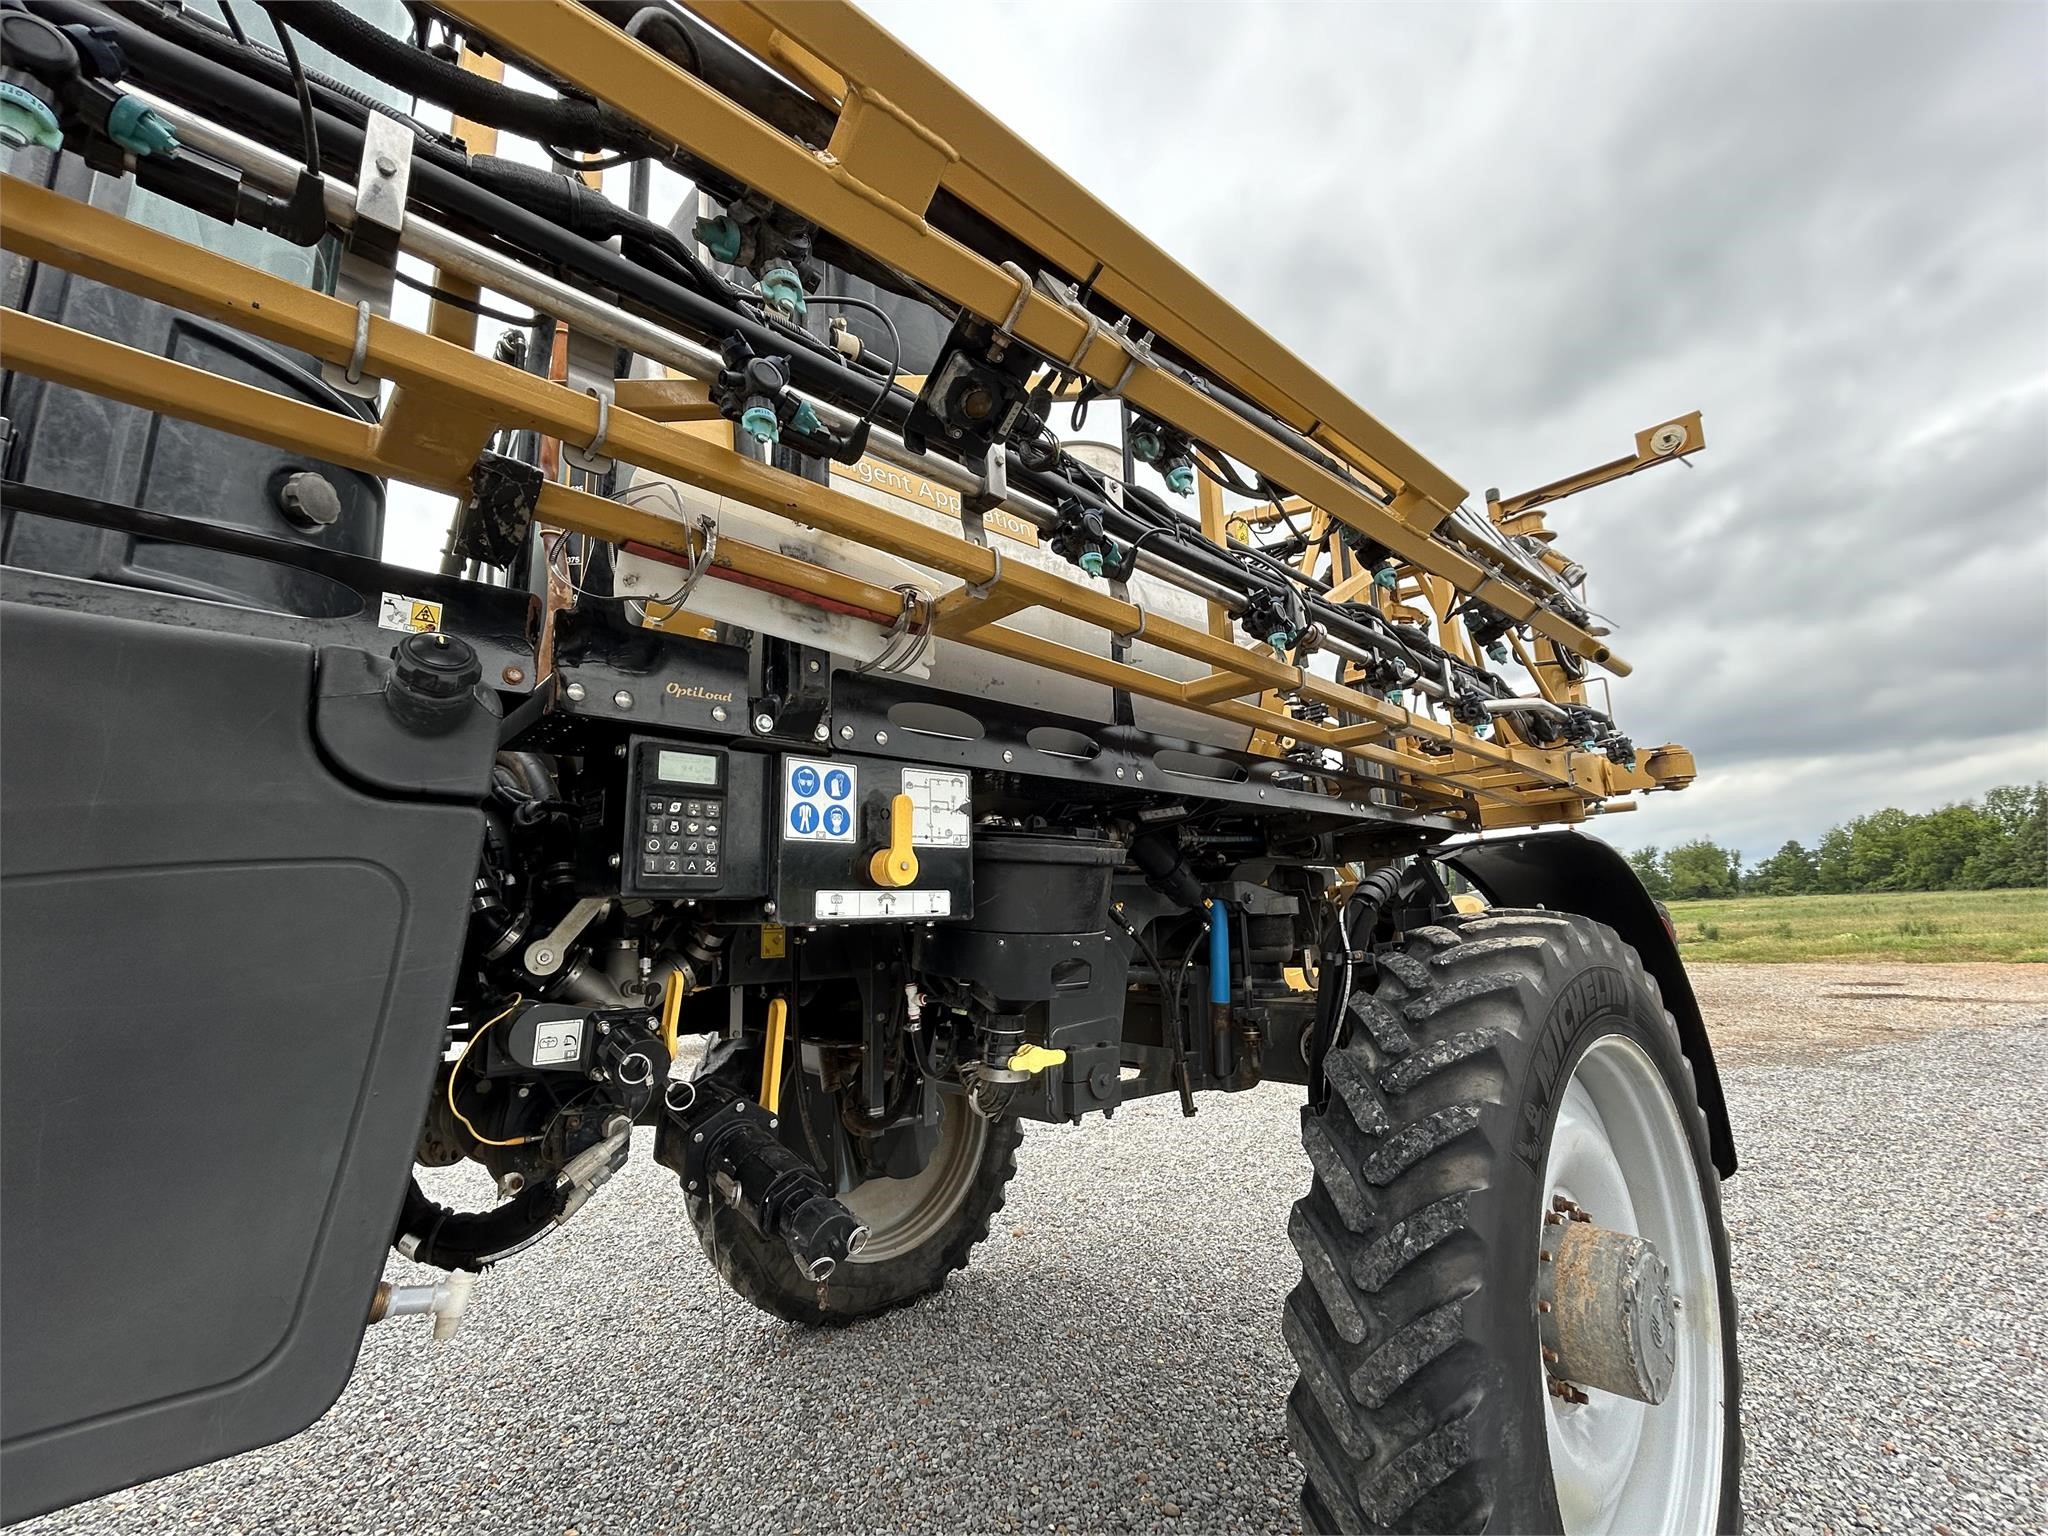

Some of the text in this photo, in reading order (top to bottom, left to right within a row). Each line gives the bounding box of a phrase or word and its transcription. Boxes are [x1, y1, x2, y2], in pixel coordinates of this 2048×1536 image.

[665, 682, 732, 702] OptiLoad
[669, 860, 676, 870] 2
[687, 861, 696, 870] A
[1533, 967, 1627, 1102] MICHELIN
